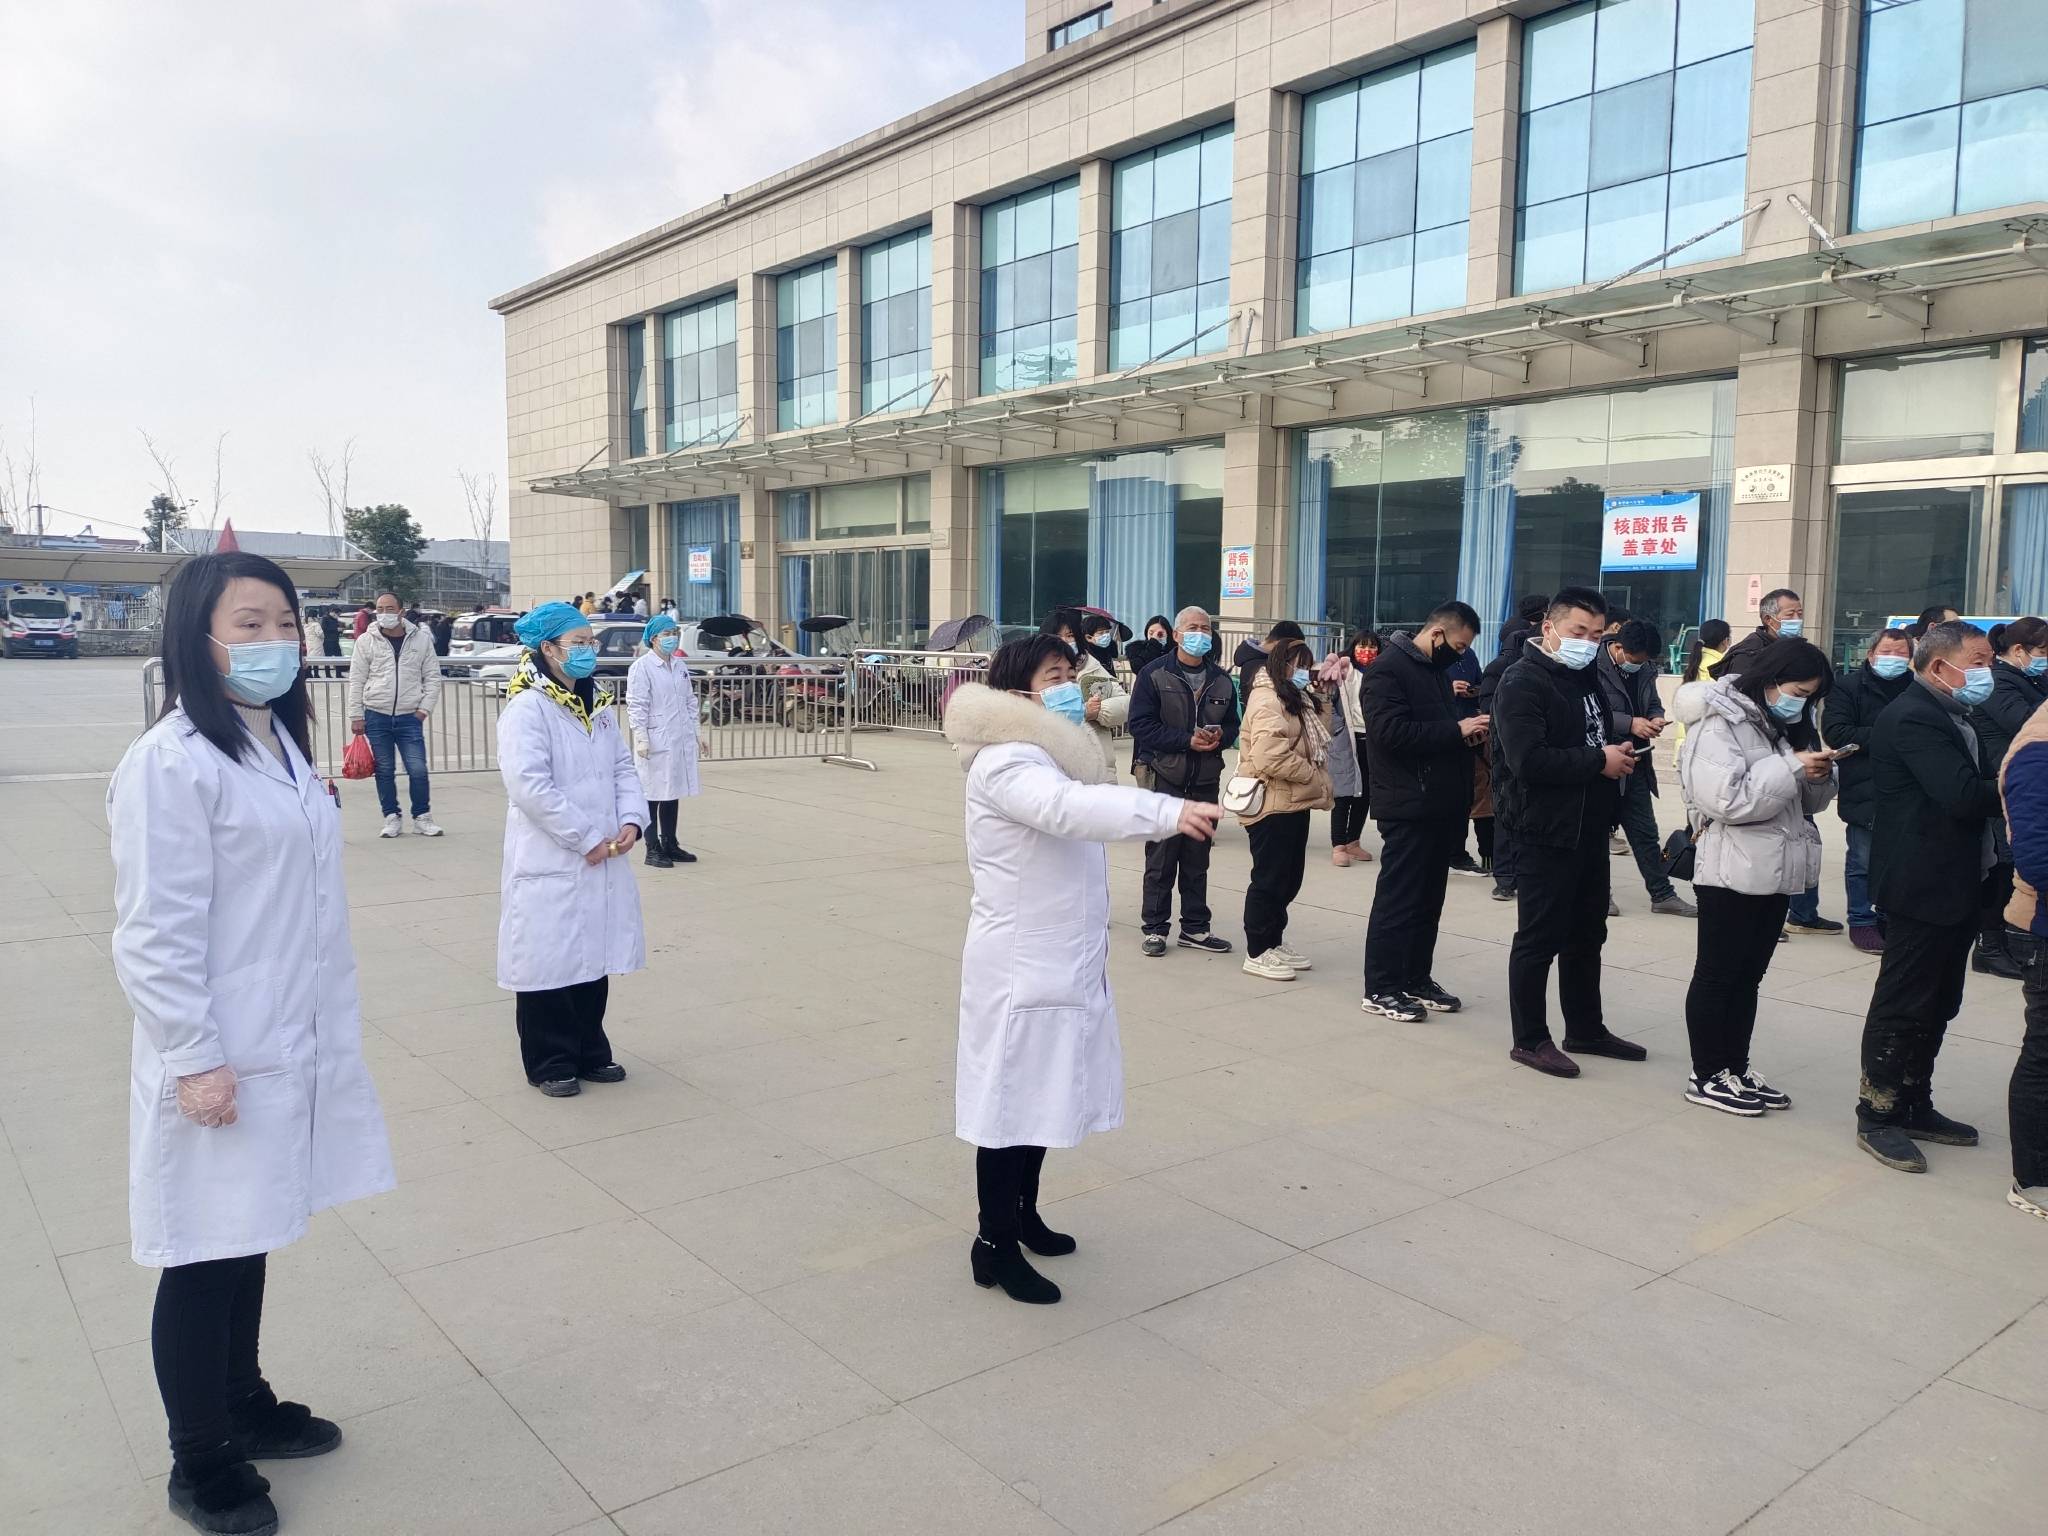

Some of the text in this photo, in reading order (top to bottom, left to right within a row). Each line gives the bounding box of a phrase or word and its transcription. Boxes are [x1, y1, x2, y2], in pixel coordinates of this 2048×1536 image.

[1614, 514, 1688, 535] 核酸报告
[1621, 537, 1677, 556] 盖章处
[1228, 552, 1249, 567] 肾病
[1227, 567, 1249, 581] 中心
